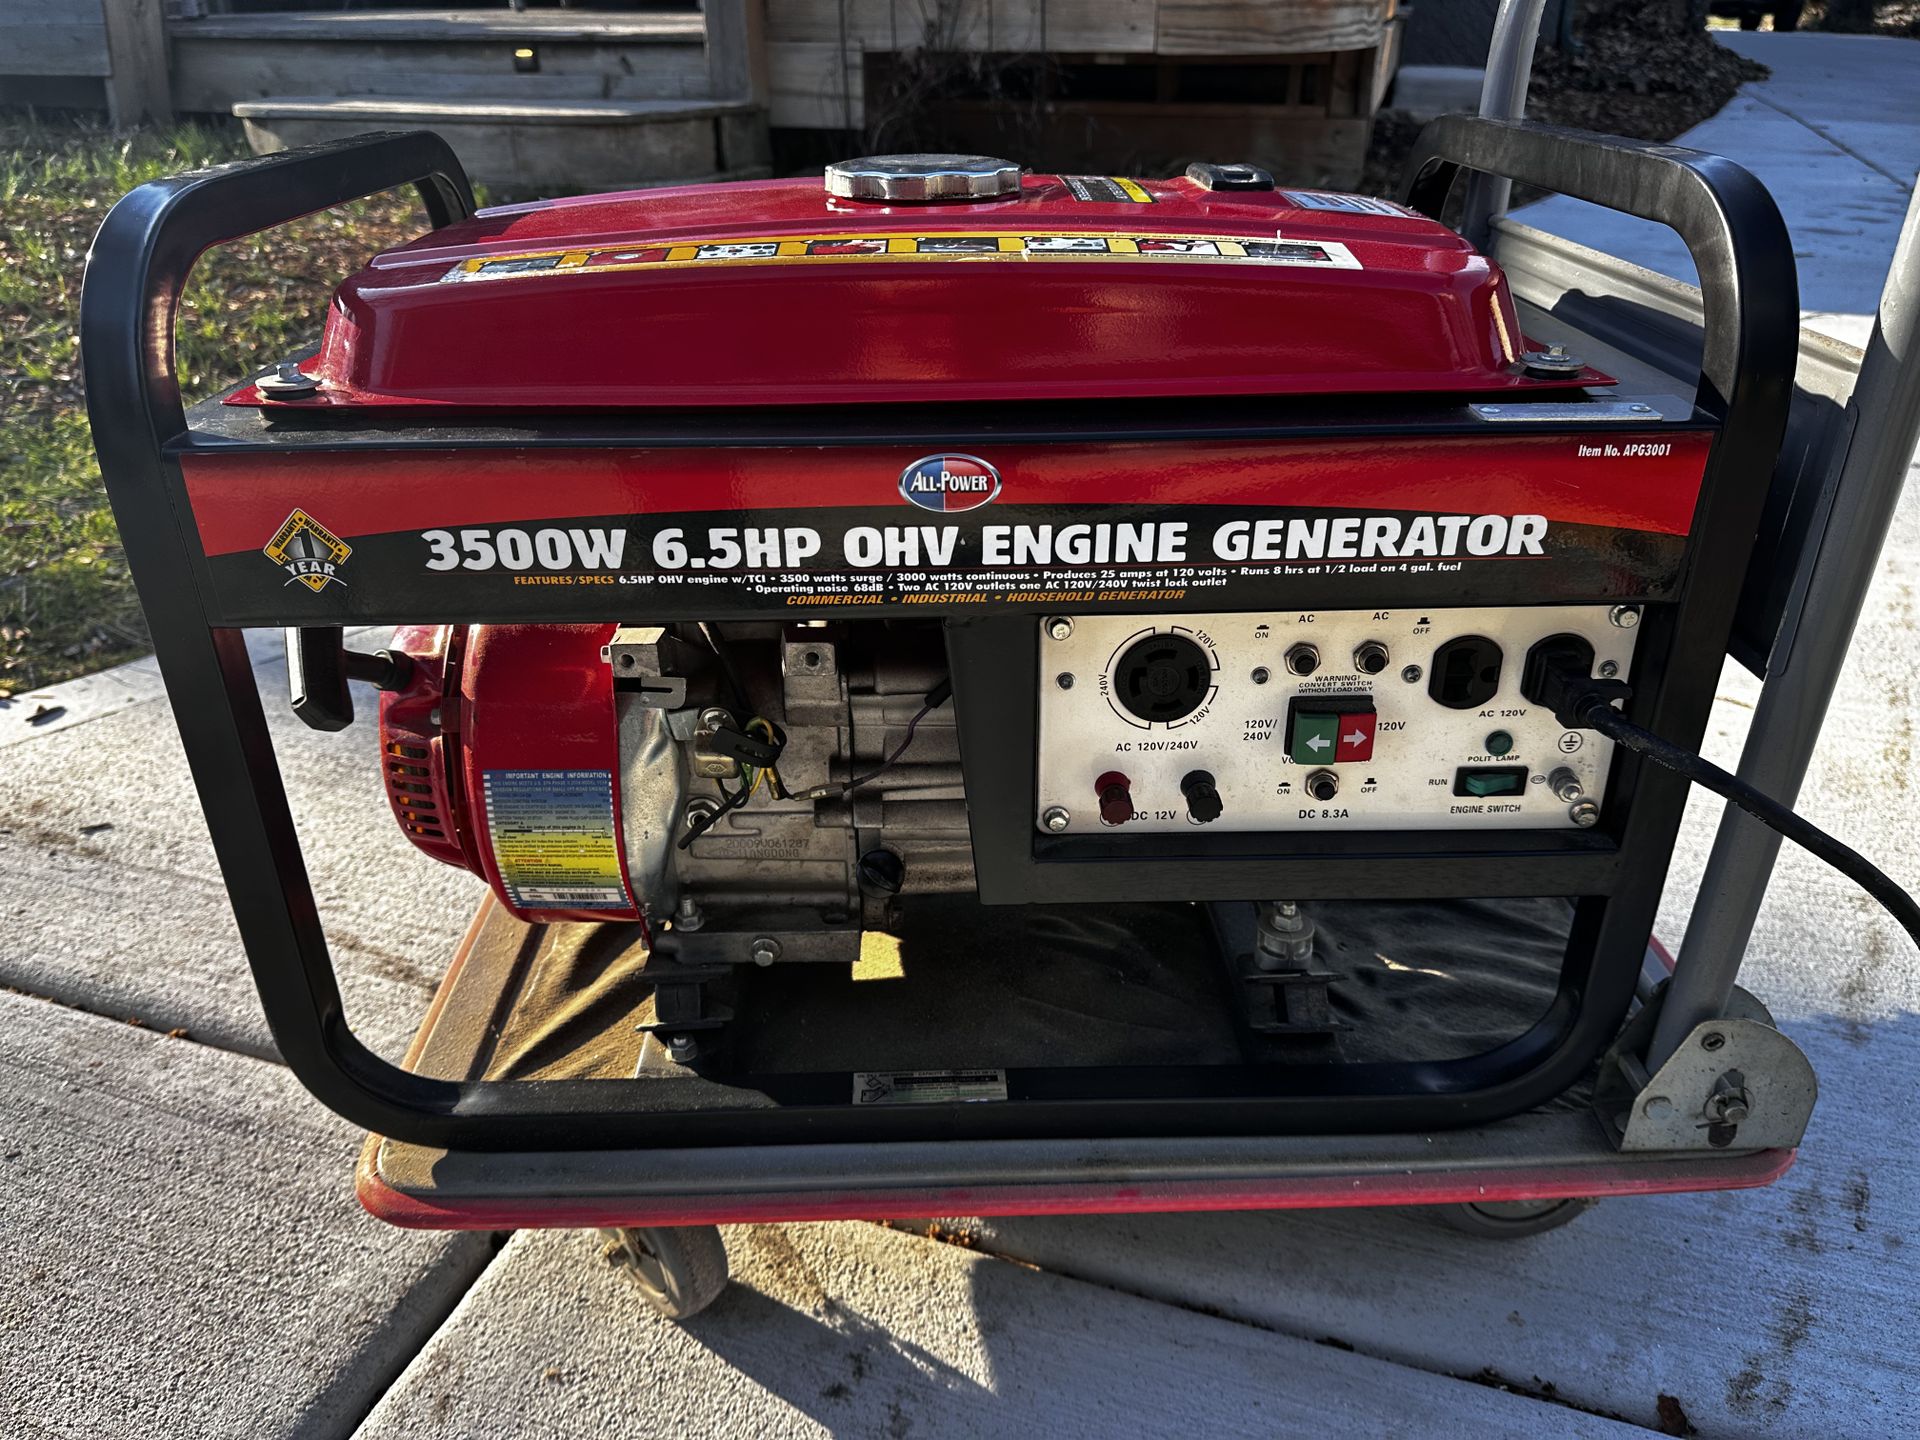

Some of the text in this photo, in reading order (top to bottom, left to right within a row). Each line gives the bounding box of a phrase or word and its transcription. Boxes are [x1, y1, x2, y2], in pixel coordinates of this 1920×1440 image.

[1578, 444, 1671, 458] Item No. APG3001
[910, 470, 988, 492] ALL-POWER
[303, 518, 340, 549] WARRANTY
[294, 528, 316, 558] 1
[421, 514, 1548, 571] 3500W 6.5HP OHV ENGINE GENERATOR
[284, 561, 336, 576] YEAR
[514, 576, 614, 585] FEATURES/SPECS
[619, 575, 654, 584] 6.5HP
[658, 575, 684, 584] OHV
[687, 575, 728, 585] engine
[732, 575, 766, 584] w/TCI
[780, 574, 810, 583] 3500
[813, 574, 846, 582] watts
[850, 574, 883, 584] surge
[896, 573, 926, 581] 3000
[930, 573, 963, 581] watts
[966, 572, 1030, 580] continuous
[1043, 571, 1096, 580] Produces
[1100, 569, 1116, 578] 25
[1119, 570, 1152, 579] amps
[1155, 569, 1169, 577] at
[1172, 568, 1194, 577] 120
[1198, 567, 1228, 576] volts
[1240, 567, 1270, 576] Runs
[1273, 566, 1282, 574] 8
[1284, 565, 1304, 574] hrs
[1307, 565, 1321, 574] at
[1325, 564, 1346, 574] 1/2
[1349, 564, 1377, 573] load
[1399, 563, 1407, 572] 4
[1410, 563, 1434, 574] gal.
[1437, 562, 1462, 571] fuel
[755, 584, 814, 594] Operating
[817, 584, 848, 593] noise
[853, 583, 884, 592] 68dB
[925, 583, 940, 591] AC
[944, 583, 973, 591] 120V
[975, 582, 1016, 590] outlets
[1045, 581, 1060, 589] AC
[1064, 580, 1128, 589] 120V/240V
[1132, 579, 1162, 588] twist
[1164, 578, 1188, 587] lock
[1192, 578, 1228, 586] outlet
[786, 590, 1186, 605] COMMERCIAL INDUSTRIAL HOUSEHOLD GENERATOR
[1298, 614, 1315, 623] AC
[1372, 612, 1389, 621] AC
[1195, 629, 1217, 650] 120V
[1100, 674, 1109, 697] 240V
[1188, 706, 1211, 726] 120V
[1500, 709, 1527, 717] 120V
[1245, 719, 1278, 730] 120V/
[1377, 721, 1406, 731] 120V
[1243, 731, 1272, 741] 240V
[1115, 740, 1198, 752] AC 120V/240V
[1131, 811, 1176, 820] DC 12V
[1299, 809, 1349, 819] DC 8.3A
[1450, 804, 1521, 814] ENGINE SWITCH
